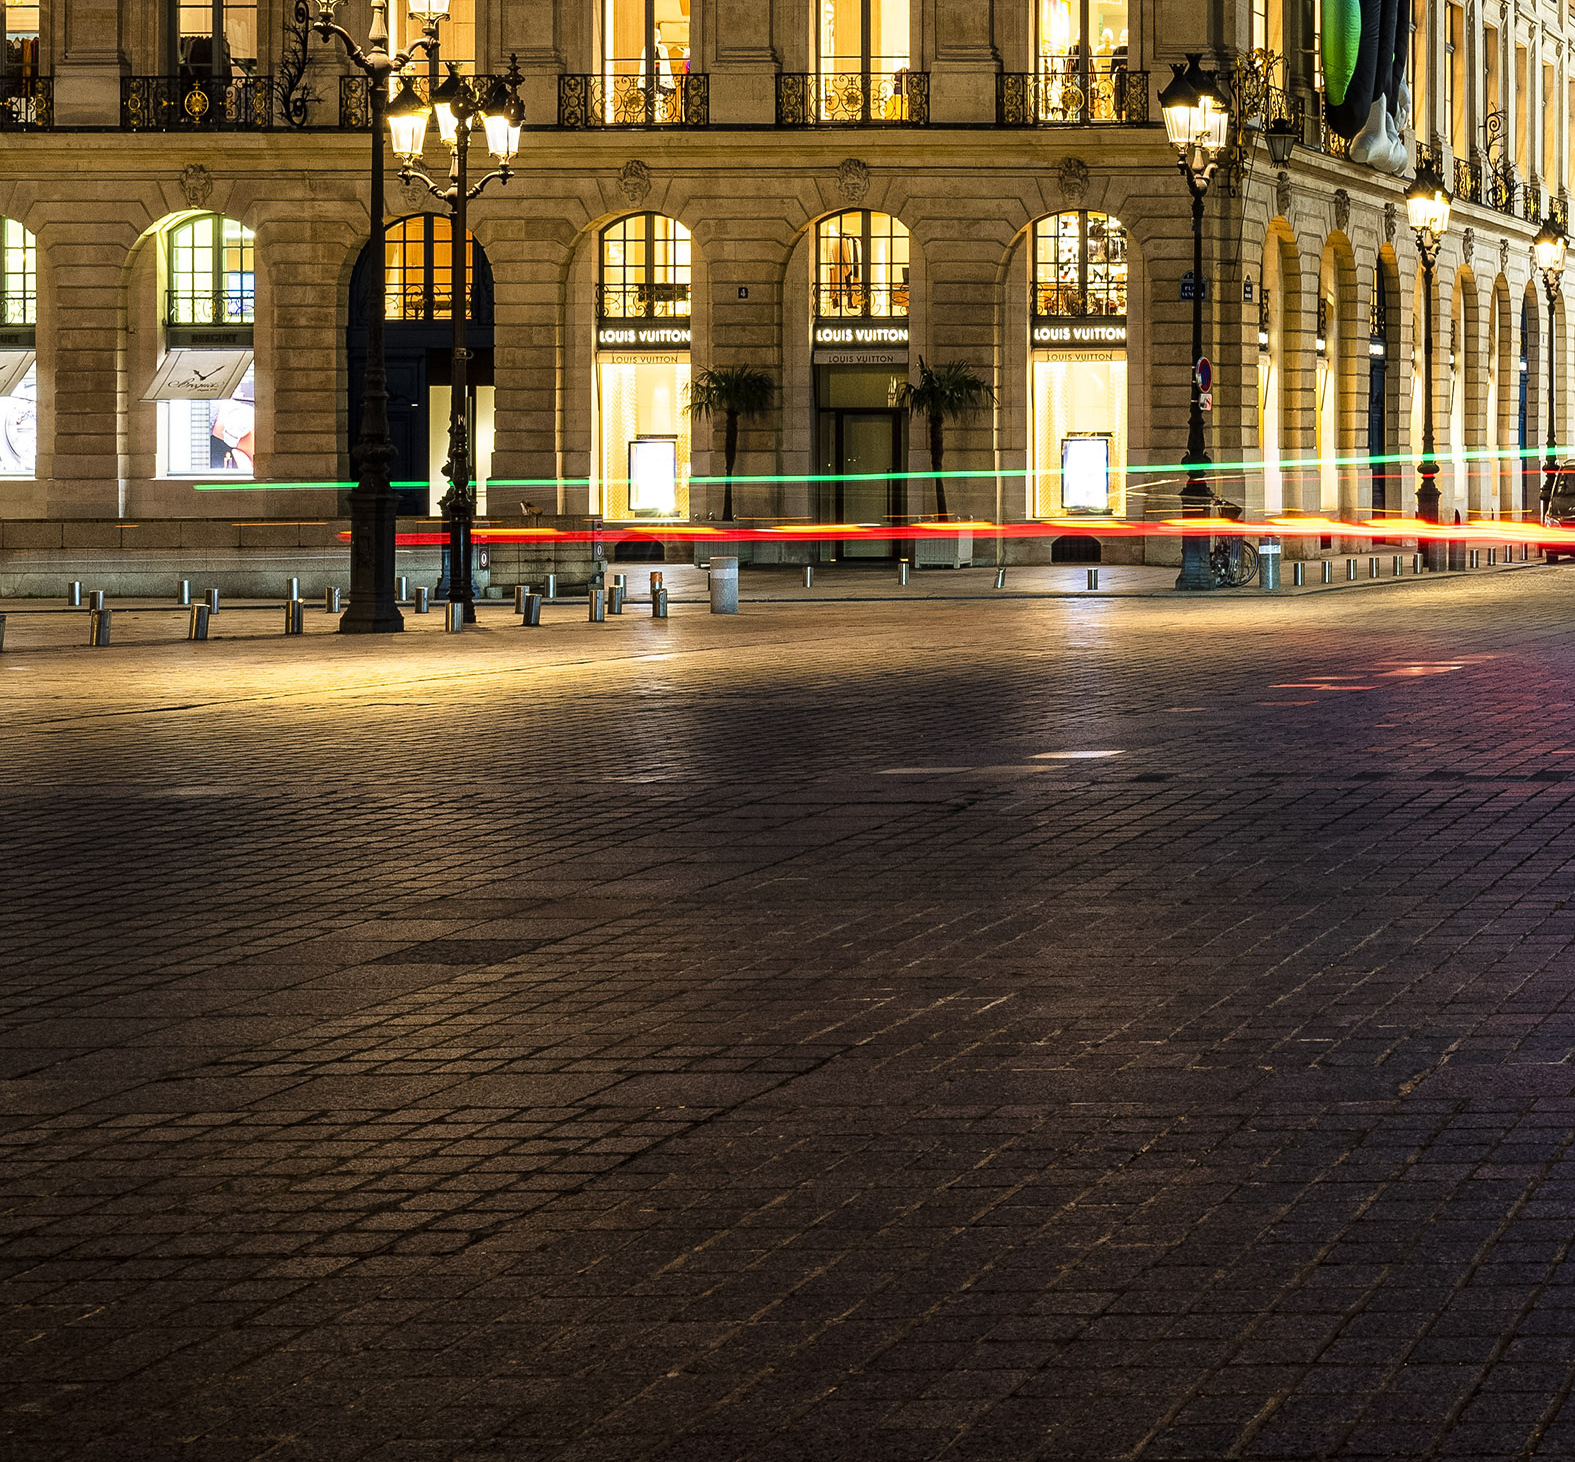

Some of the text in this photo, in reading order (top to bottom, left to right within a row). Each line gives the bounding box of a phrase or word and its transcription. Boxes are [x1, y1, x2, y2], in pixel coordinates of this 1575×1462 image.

[599, 330, 691, 342] LOUIS VUITTON
[816, 329, 909, 342] LOUIS VUITTON
[1034, 327, 1126, 341] LOUIS VUITTON
[828, 355, 894, 363] LOUIS VUITTON
